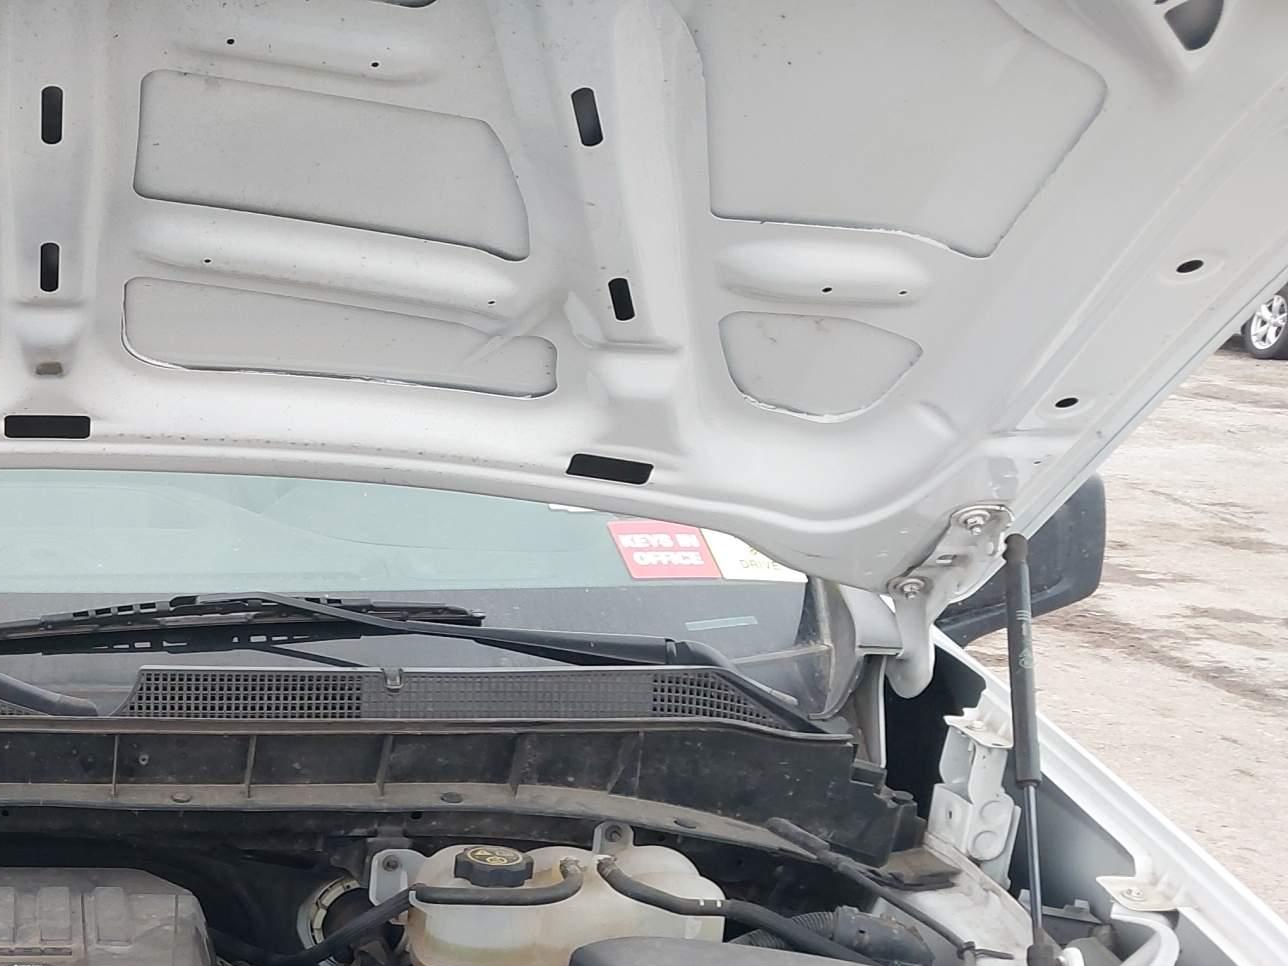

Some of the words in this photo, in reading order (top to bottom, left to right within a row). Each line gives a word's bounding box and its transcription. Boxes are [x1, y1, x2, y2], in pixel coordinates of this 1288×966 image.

[617, 533, 674, 548] KEYS
[675, 533, 700, 548] IN
[632, 551, 705, 566] OFFICE
